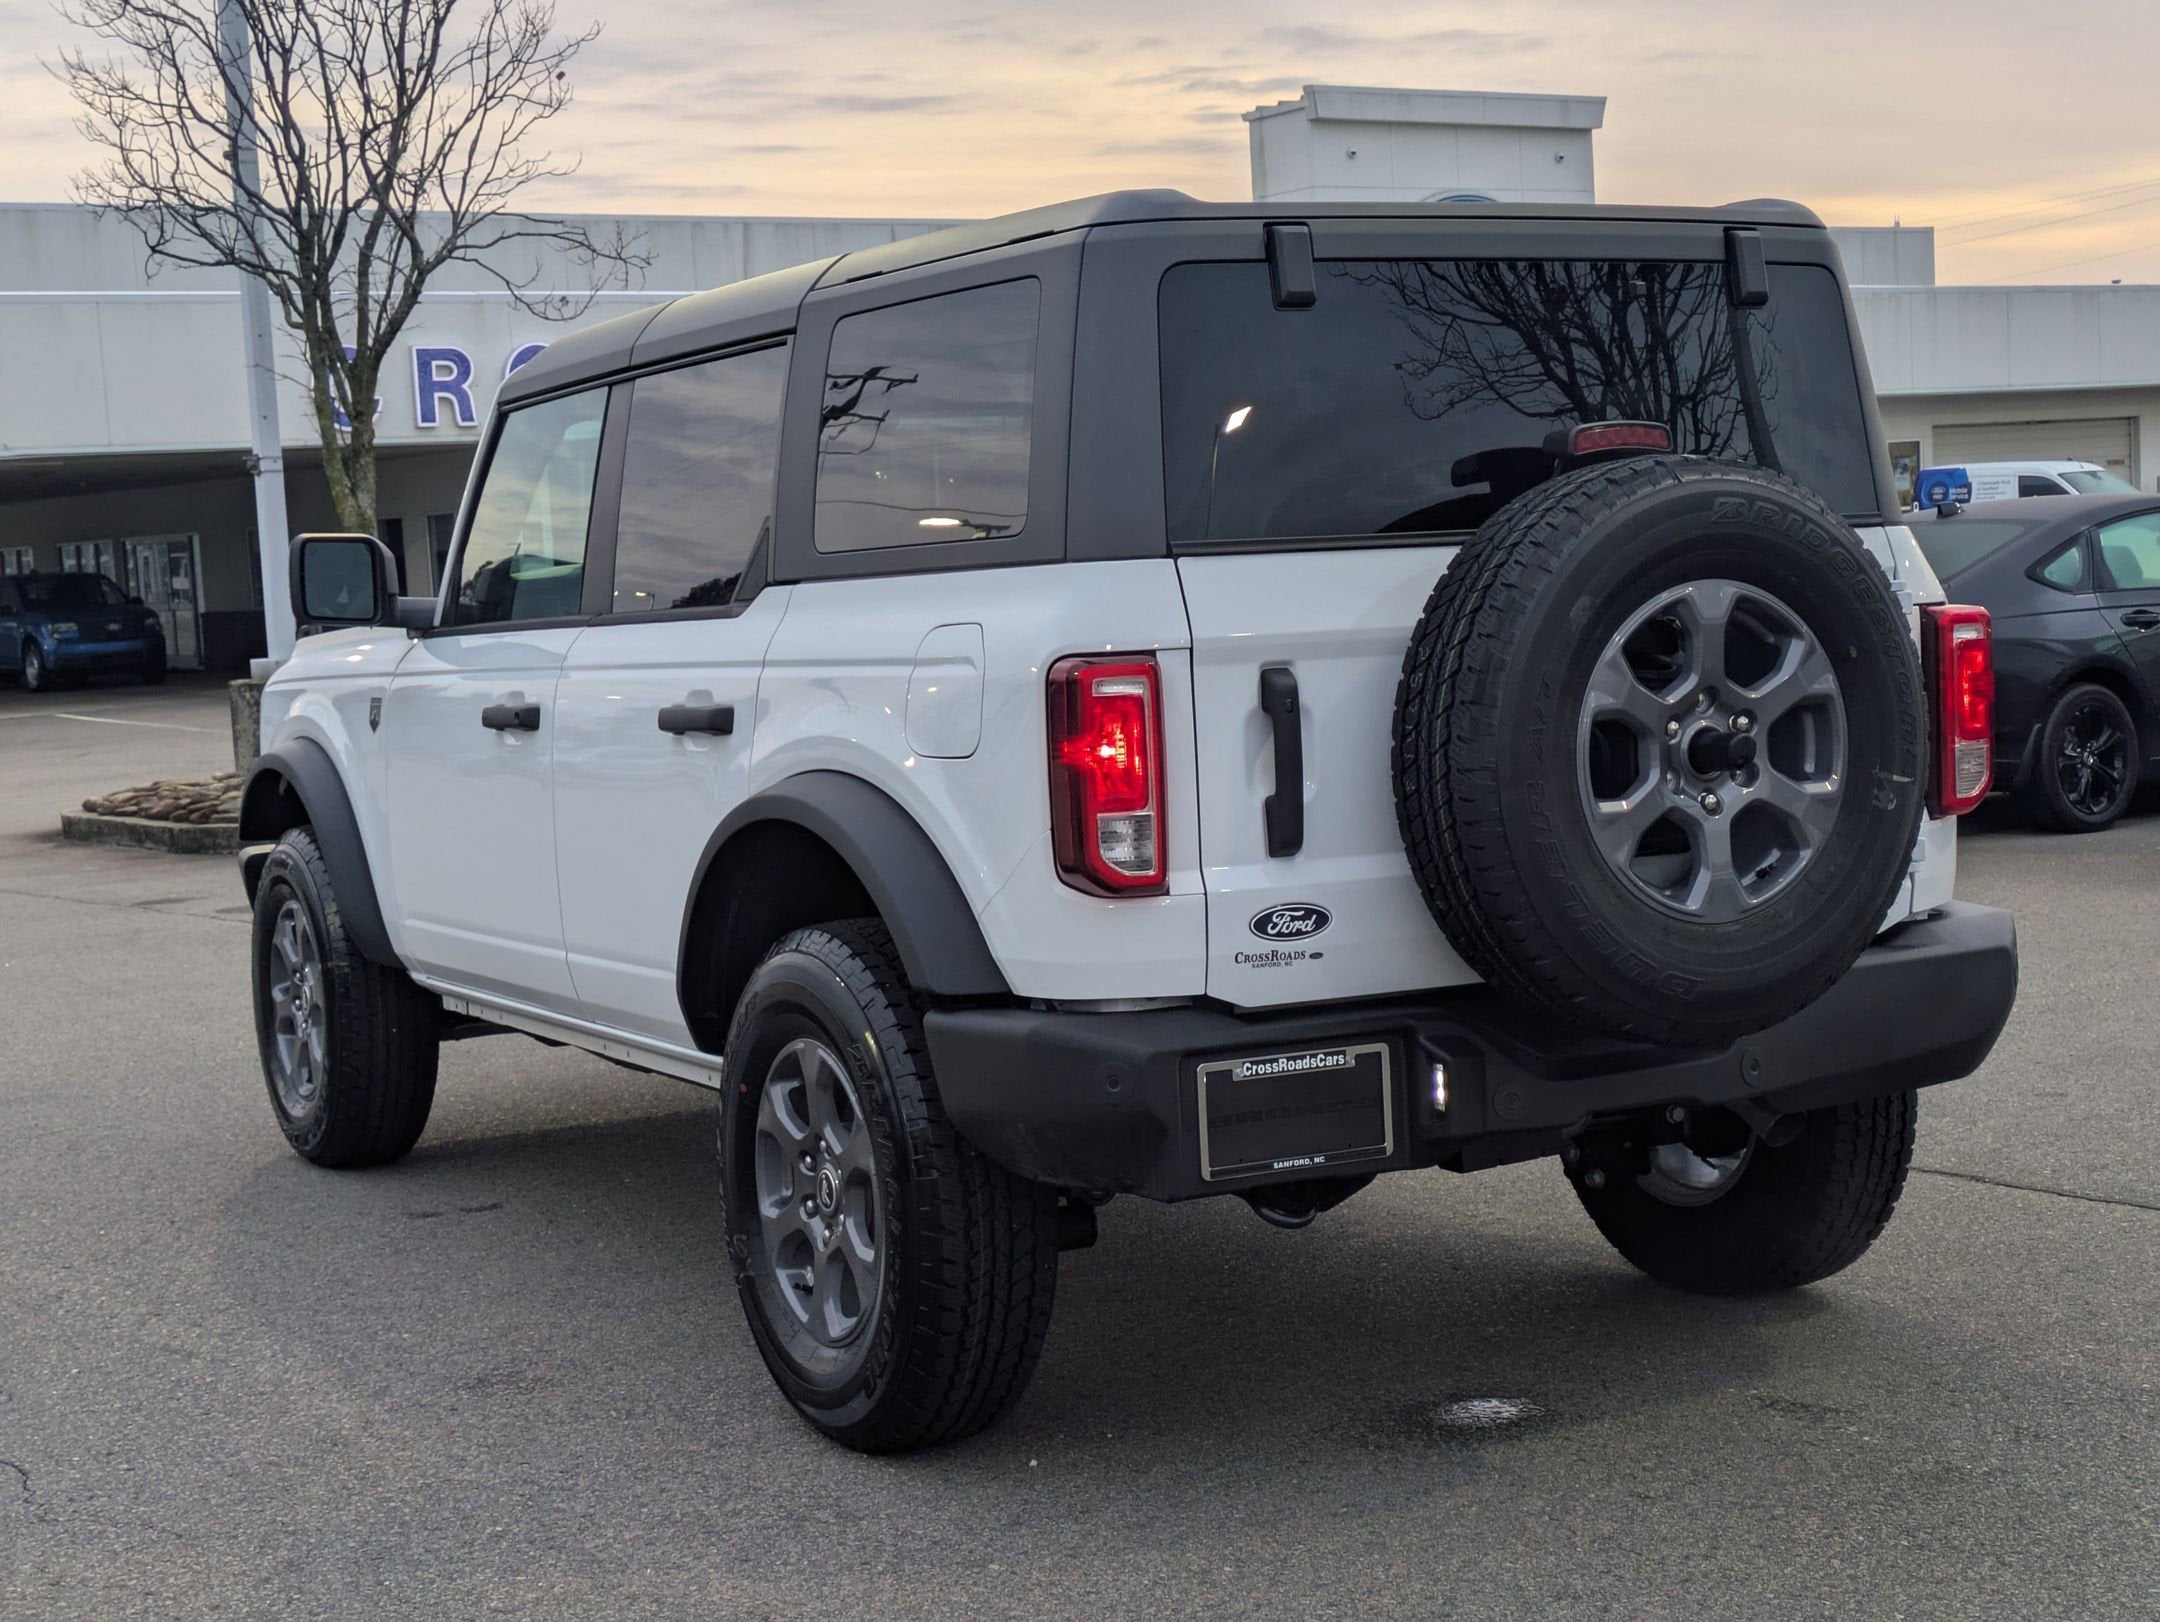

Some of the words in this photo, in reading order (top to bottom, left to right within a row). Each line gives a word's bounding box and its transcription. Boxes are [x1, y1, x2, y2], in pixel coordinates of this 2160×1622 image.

[1710, 496, 1919, 770] BRIDGESTONE
[1267, 910, 1317, 935] Ford
[1243, 1053, 1345, 1076] CrossRoadsCars
[1273, 1158, 1313, 1169] SANFORD,
[1313, 1156, 1326, 1164] NC
